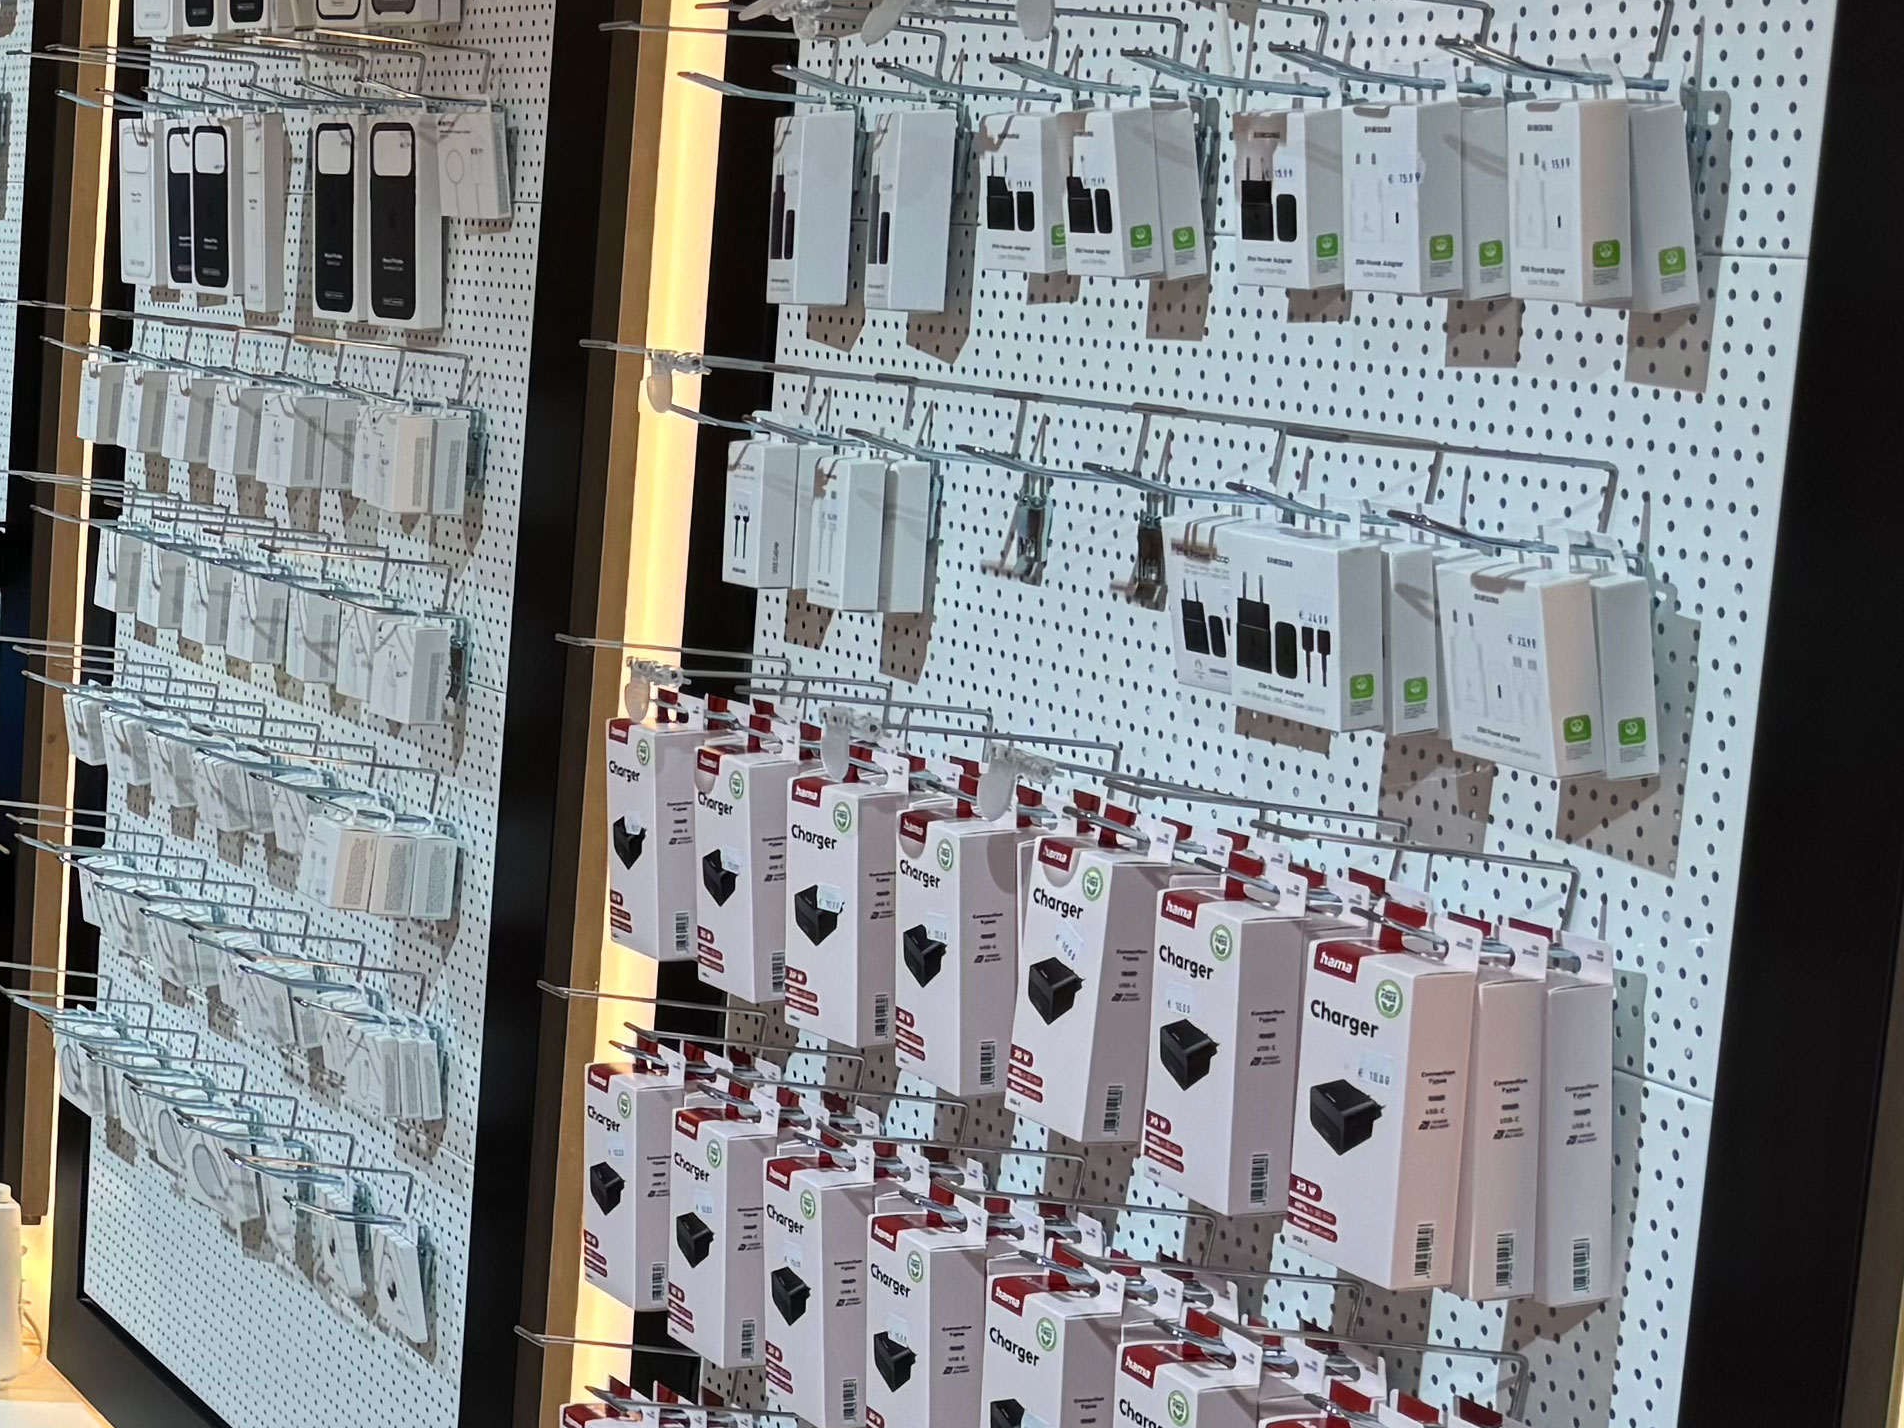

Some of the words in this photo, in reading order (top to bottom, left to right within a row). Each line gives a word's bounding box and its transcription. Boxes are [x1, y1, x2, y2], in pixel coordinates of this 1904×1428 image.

[1267, 555, 1293, 568] SAMSUNG
[608, 760, 641, 783] Charger
[697, 792, 734, 815] Charger
[791, 824, 837, 851] Charger
[1042, 844, 1068, 864] hama
[899, 858, 941, 889] Charger
[1033, 887, 1084, 920] Charger
[1166, 900, 1193, 921] hama
[1159, 944, 1214, 981] Charger
[1319, 951, 1354, 974] hama
[1310, 999, 1379, 1038] Charger
[587, 1105, 621, 1133] Charger
[674, 1152, 710, 1182] Charger
[766, 1203, 805, 1235] Charger
[870, 1264, 911, 1299] Charger
[995, 1284, 1021, 1309] hama
[989, 1326, 1040, 1368] Charger
[1125, 1354, 1152, 1380] hama
